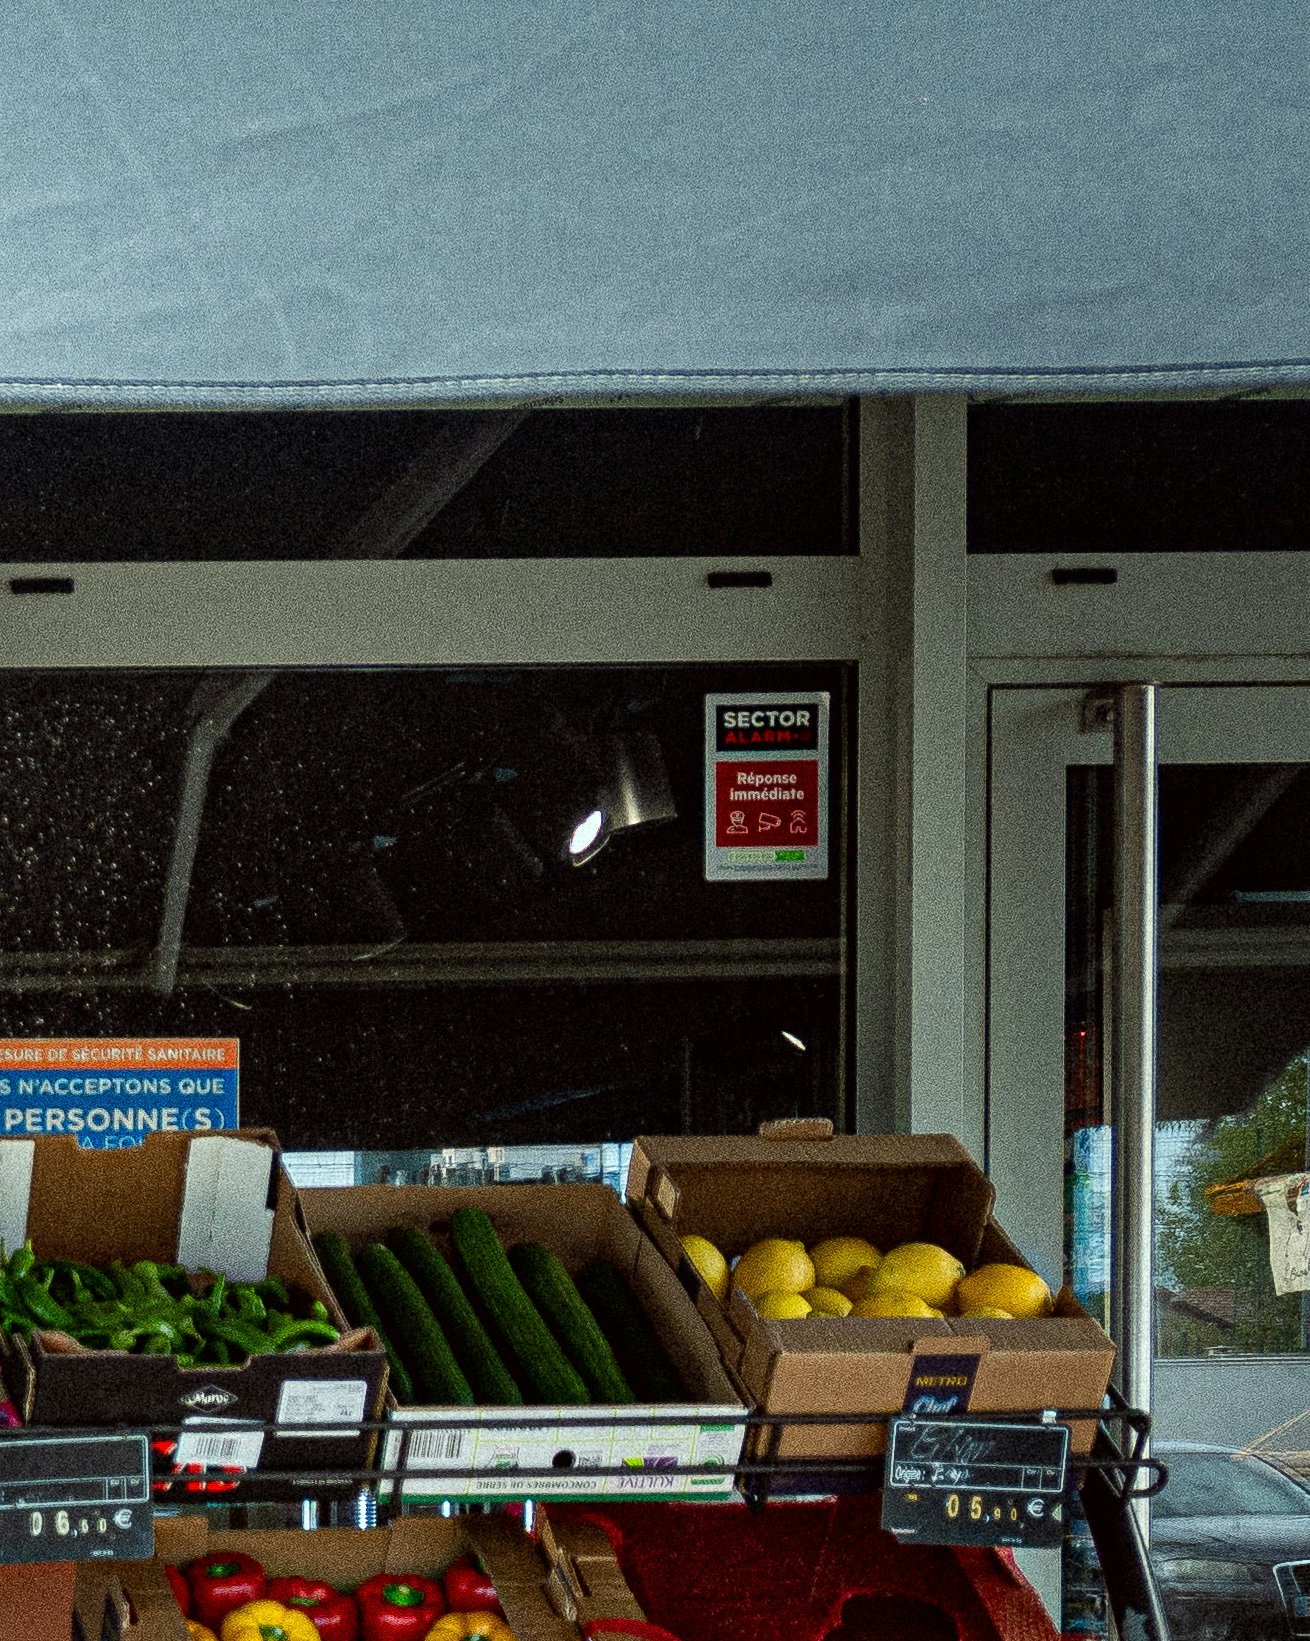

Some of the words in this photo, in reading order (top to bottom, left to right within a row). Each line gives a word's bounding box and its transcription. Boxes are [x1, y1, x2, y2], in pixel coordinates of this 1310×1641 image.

[723, 711, 810, 727] SECTOR
[725, 731, 791, 744] ALARM
[736, 771, 797, 786] Réponse
[730, 787, 805, 801] immédiate
[47, 1048, 66, 1061] DE
[72, 1045, 143, 1061] SÉCURITÉ
[148, 1048, 225, 1061] SANITAIRE
[18, 1079, 172, 1095] N'ACCEPTONS
[178, 1079, 225, 1095] QUE
[3, 1107, 226, 1132] PERSONNE(S)
[915, 1375, 969, 1387] METRO
